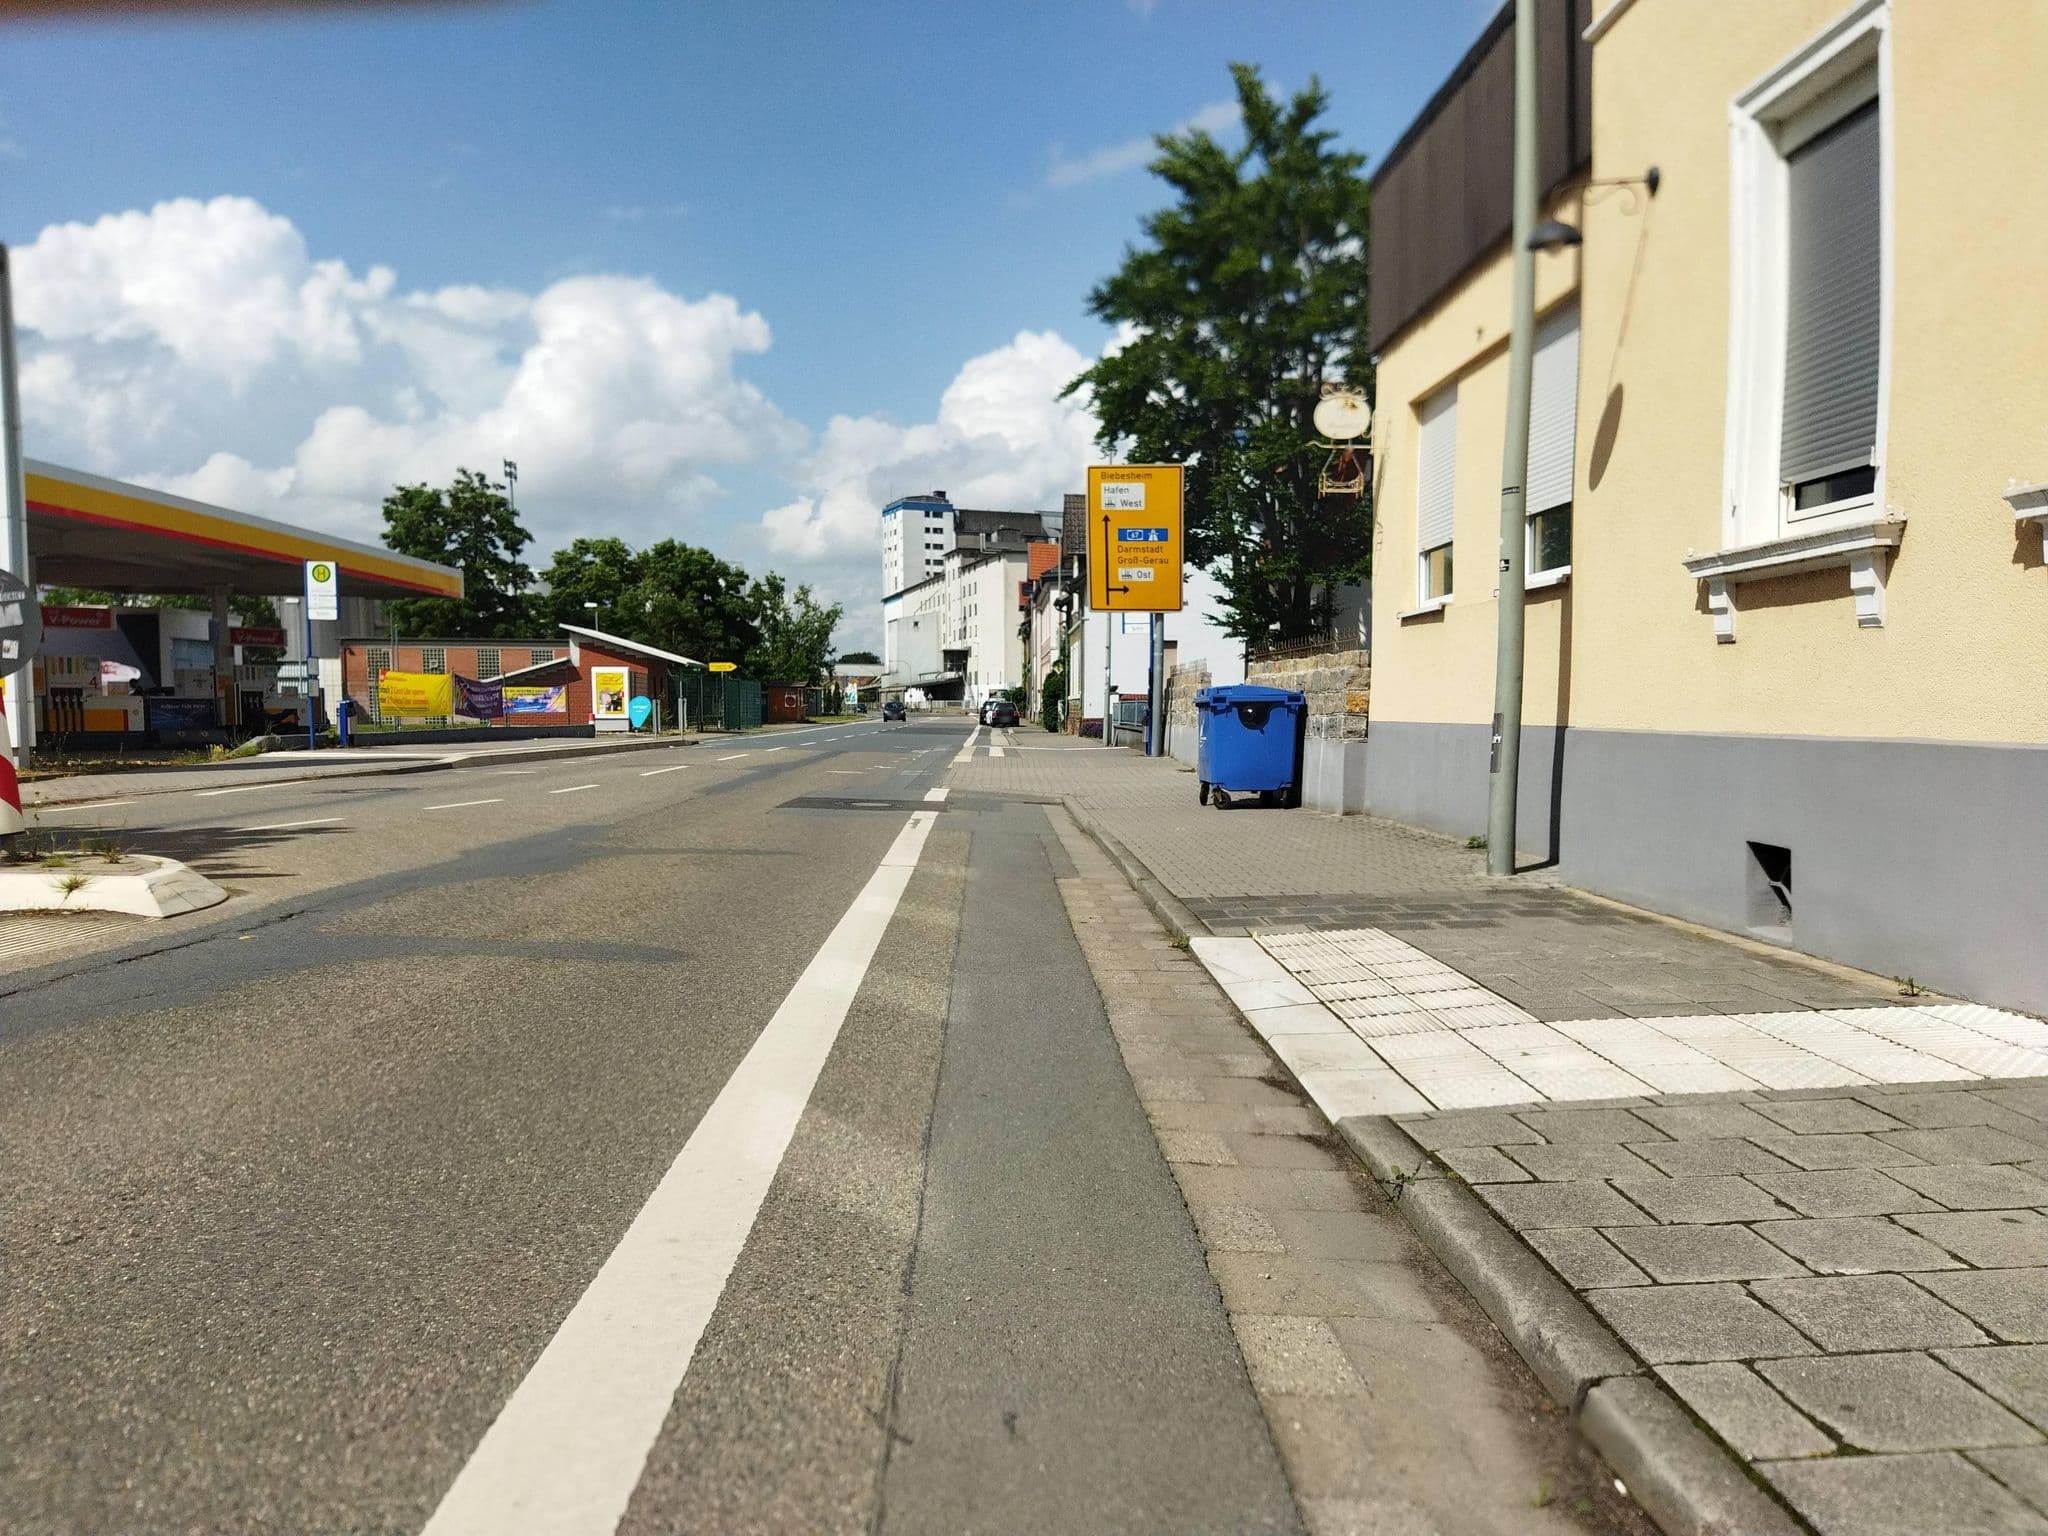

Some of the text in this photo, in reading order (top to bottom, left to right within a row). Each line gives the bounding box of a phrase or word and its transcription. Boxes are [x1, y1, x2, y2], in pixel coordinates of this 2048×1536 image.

[1100, 471, 1153, 480] Biebesheim
[1103, 485, 1130, 494] Hafen
[1120, 499, 1143, 508] West
[1130, 531, 1139, 540] 67
[1117, 545, 1163, 554] Darmstadt
[1117, 556, 1169, 565] Groß-Gerau
[317, 567, 326, 580] H
[1136, 570, 1152, 579] Ost
